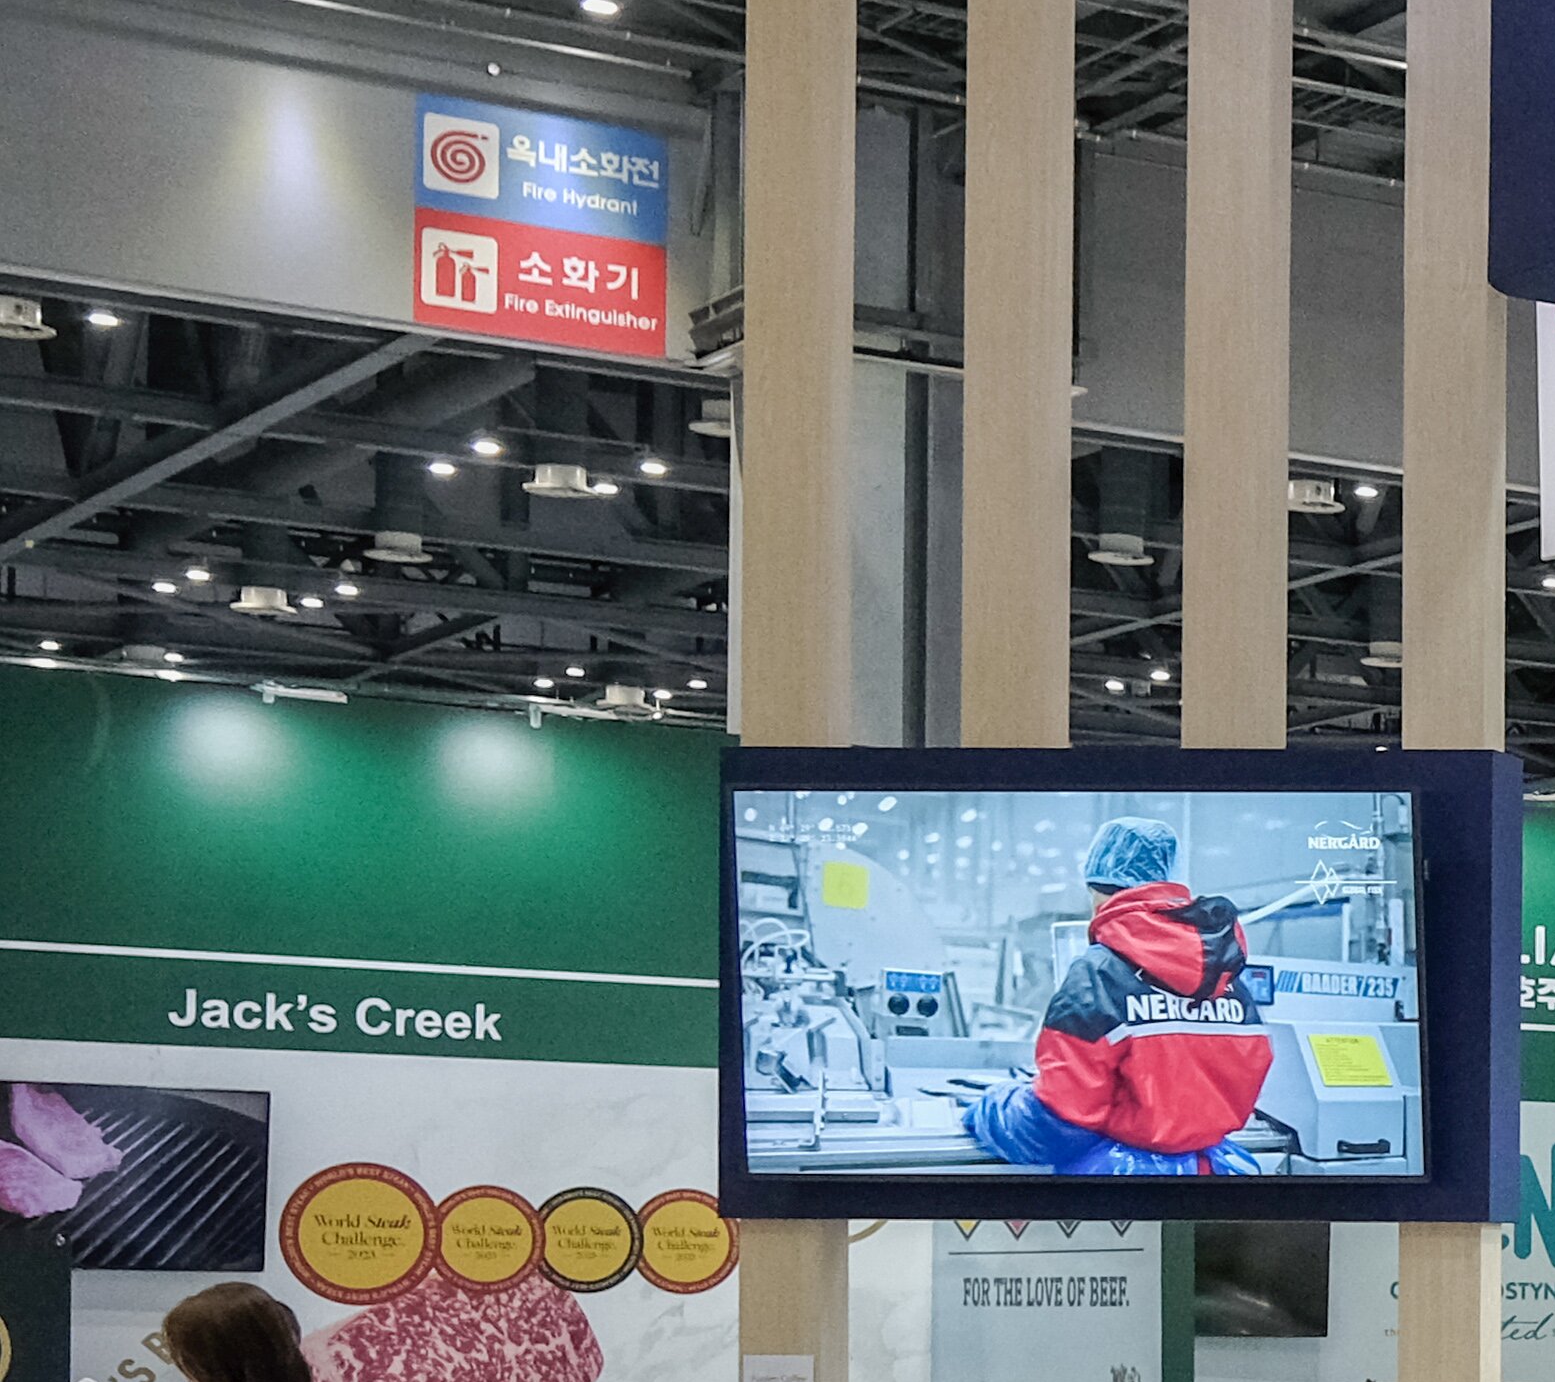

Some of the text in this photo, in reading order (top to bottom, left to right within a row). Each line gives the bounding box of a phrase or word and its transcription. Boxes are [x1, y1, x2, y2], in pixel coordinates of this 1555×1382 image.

[506, 135, 660, 188] 옥내소화전
[523, 182, 637, 216] Fire Hydrant
[504, 293, 657, 330] Fire Extinguisher
[1368, 977, 1395, 997] 235
[355, 998, 502, 1041] Creek
[313, 1214, 412, 1229] World Steak
[963, 1276, 1130, 1307] FOR THE LOVE OF BEEF.
